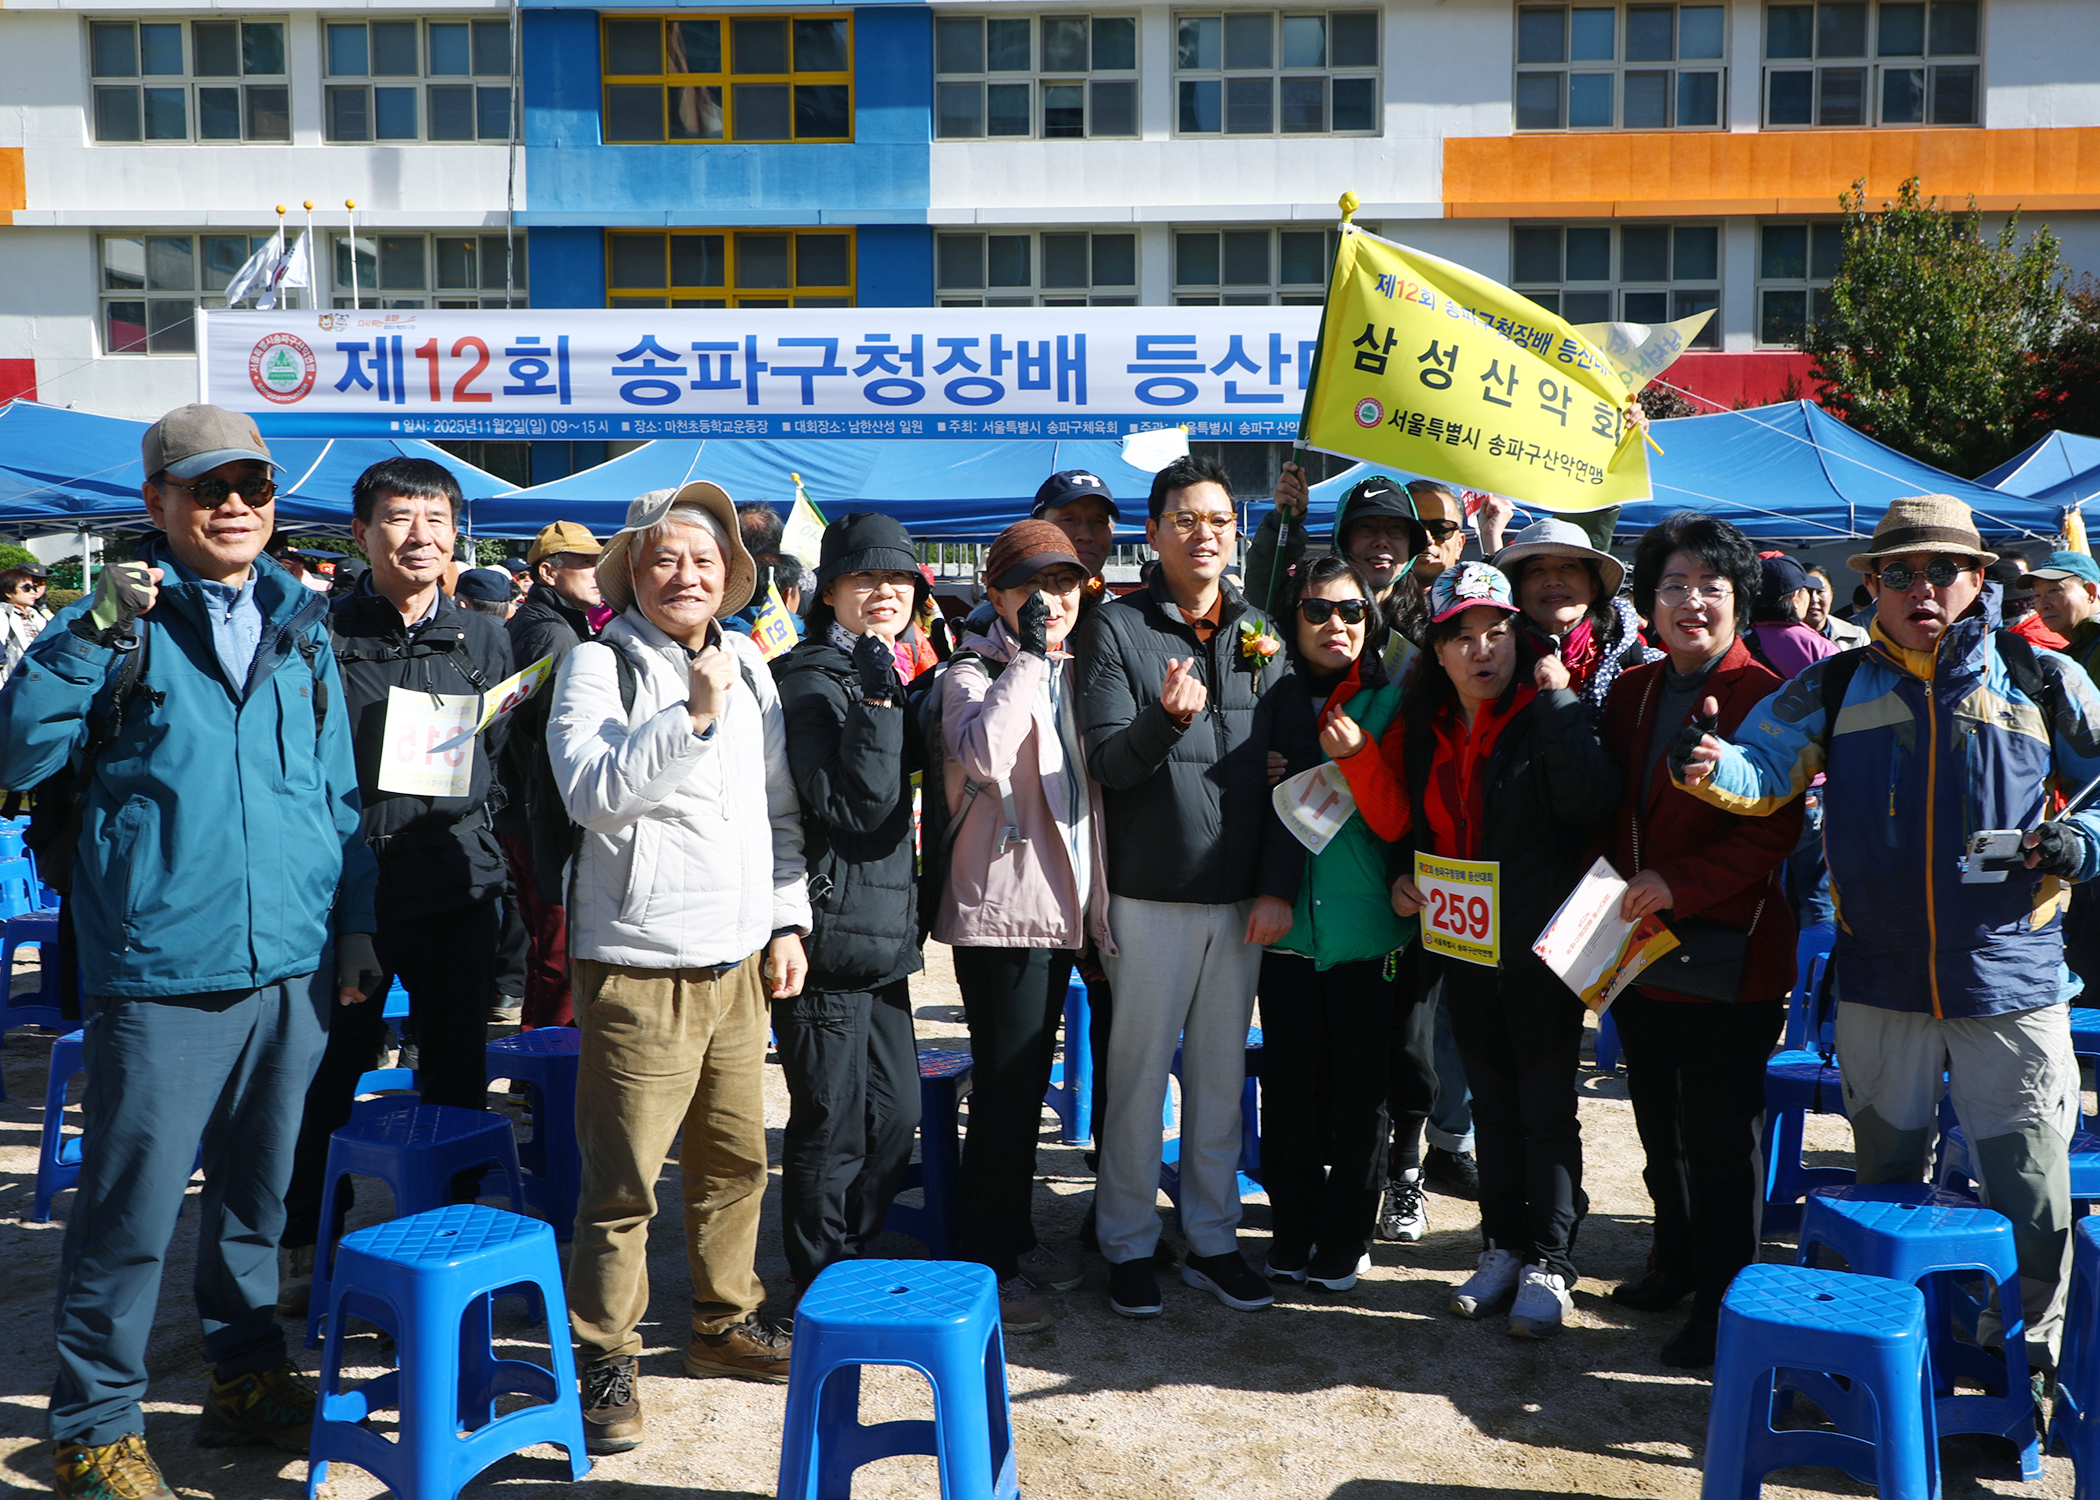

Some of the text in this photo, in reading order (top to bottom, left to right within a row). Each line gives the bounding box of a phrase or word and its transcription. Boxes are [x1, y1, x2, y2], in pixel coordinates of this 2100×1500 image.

[1374, 272, 1436, 311] 제12회
[1444, 300, 1554, 356] 송파구청장배
[333, 334, 572, 405] 제12회
[611, 332, 1088, 406] 송파구청장배
[403, 419, 431, 434] 일시:
[433, 418, 547, 436] 2025년11월2일(일)
[634, 419, 662, 434] 장소:
[664, 419, 769, 435] 마천초등학교운동장
[794, 419, 846, 435] 대회장소:
[848, 420, 896, 435] 남한산성
[899, 420, 924, 435] 일원
[948, 420, 978, 435] 주최:
[981, 420, 1041, 436] 서울특별시
[1046, 420, 1119, 436] 송파구체육회
[1387, 408, 1481, 450] 서울특별시
[1487, 432, 1604, 485] 송파구산악연맹
[1430, 888, 1490, 940] 259
